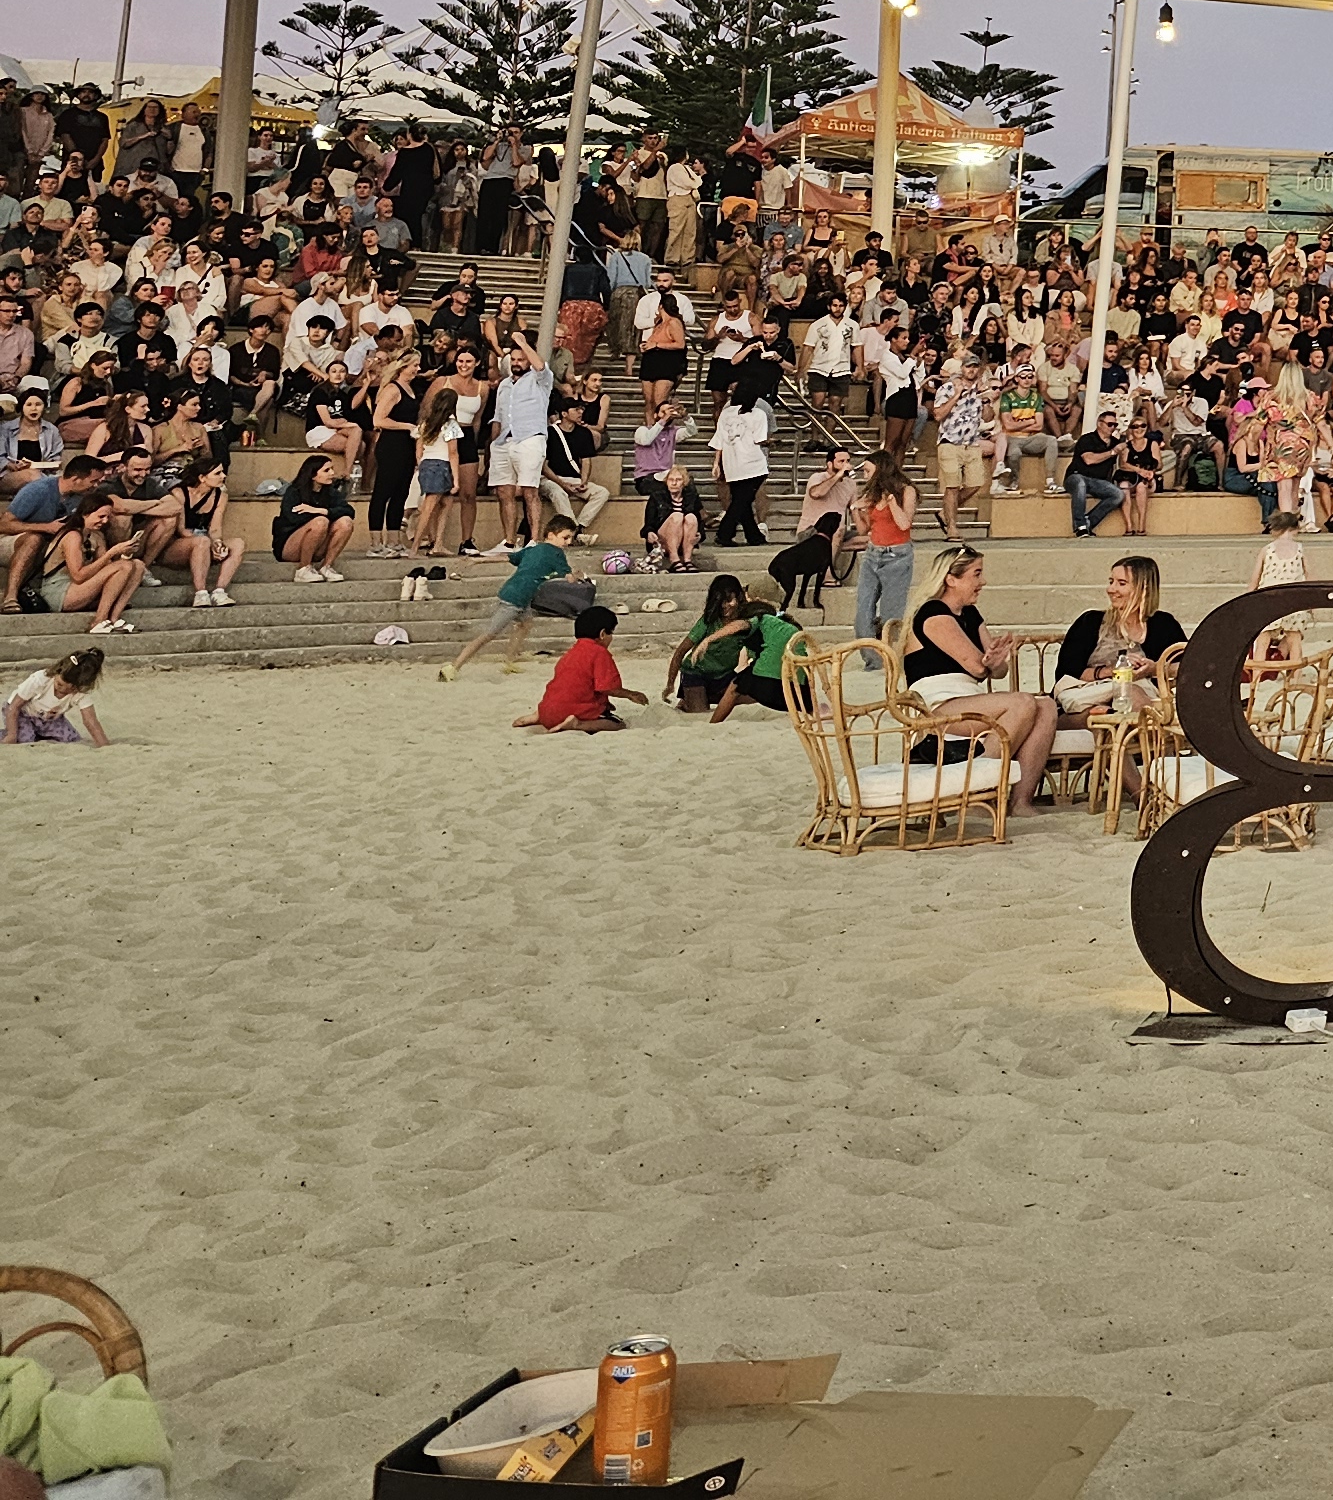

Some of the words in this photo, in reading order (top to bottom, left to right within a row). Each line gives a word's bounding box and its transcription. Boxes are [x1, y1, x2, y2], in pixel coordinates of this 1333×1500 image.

[827, 118, 875, 134] Antica
[896, 124, 945, 138] lateria
[951, 128, 1003, 141] Italiana
